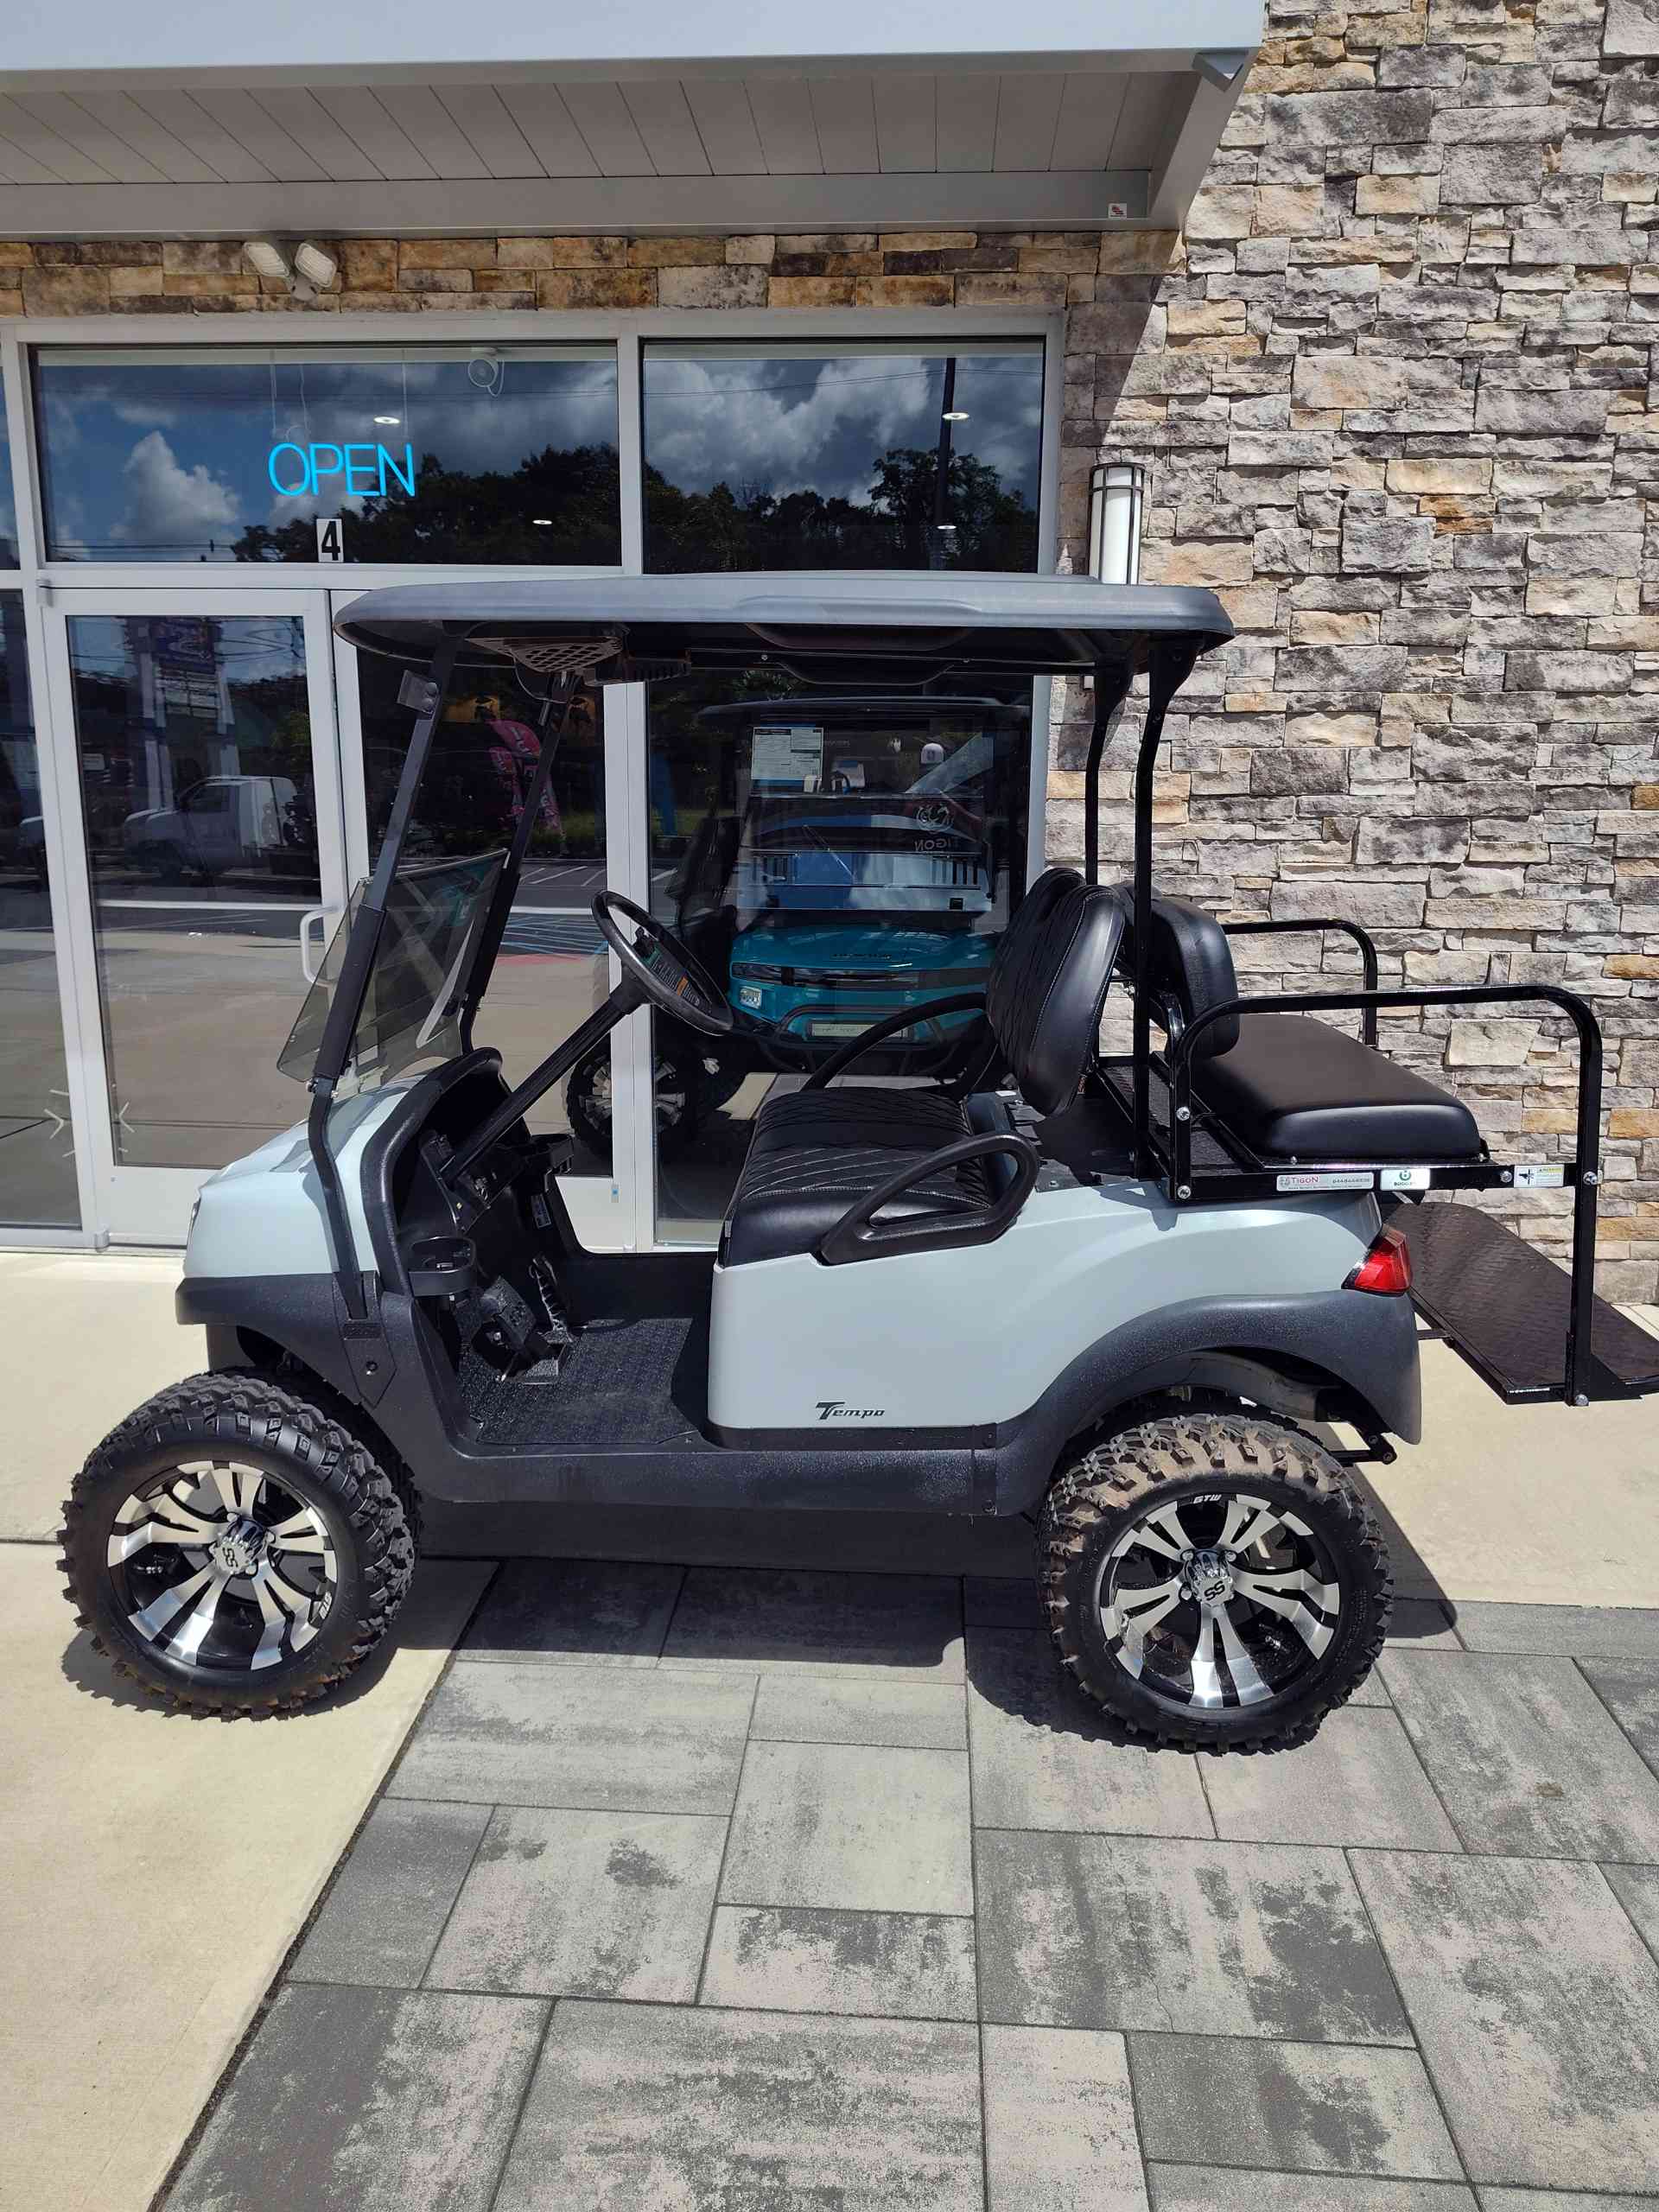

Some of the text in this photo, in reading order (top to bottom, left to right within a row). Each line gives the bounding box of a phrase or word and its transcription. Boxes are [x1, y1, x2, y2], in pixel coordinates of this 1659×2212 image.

[268, 442, 416, 497] OPEN
[321, 520, 341, 562] 4
[815, 1402, 886, 1420] Tempo
[1193, 1493, 1222, 1504] GTW
[1205, 1580, 1225, 1600] SS
